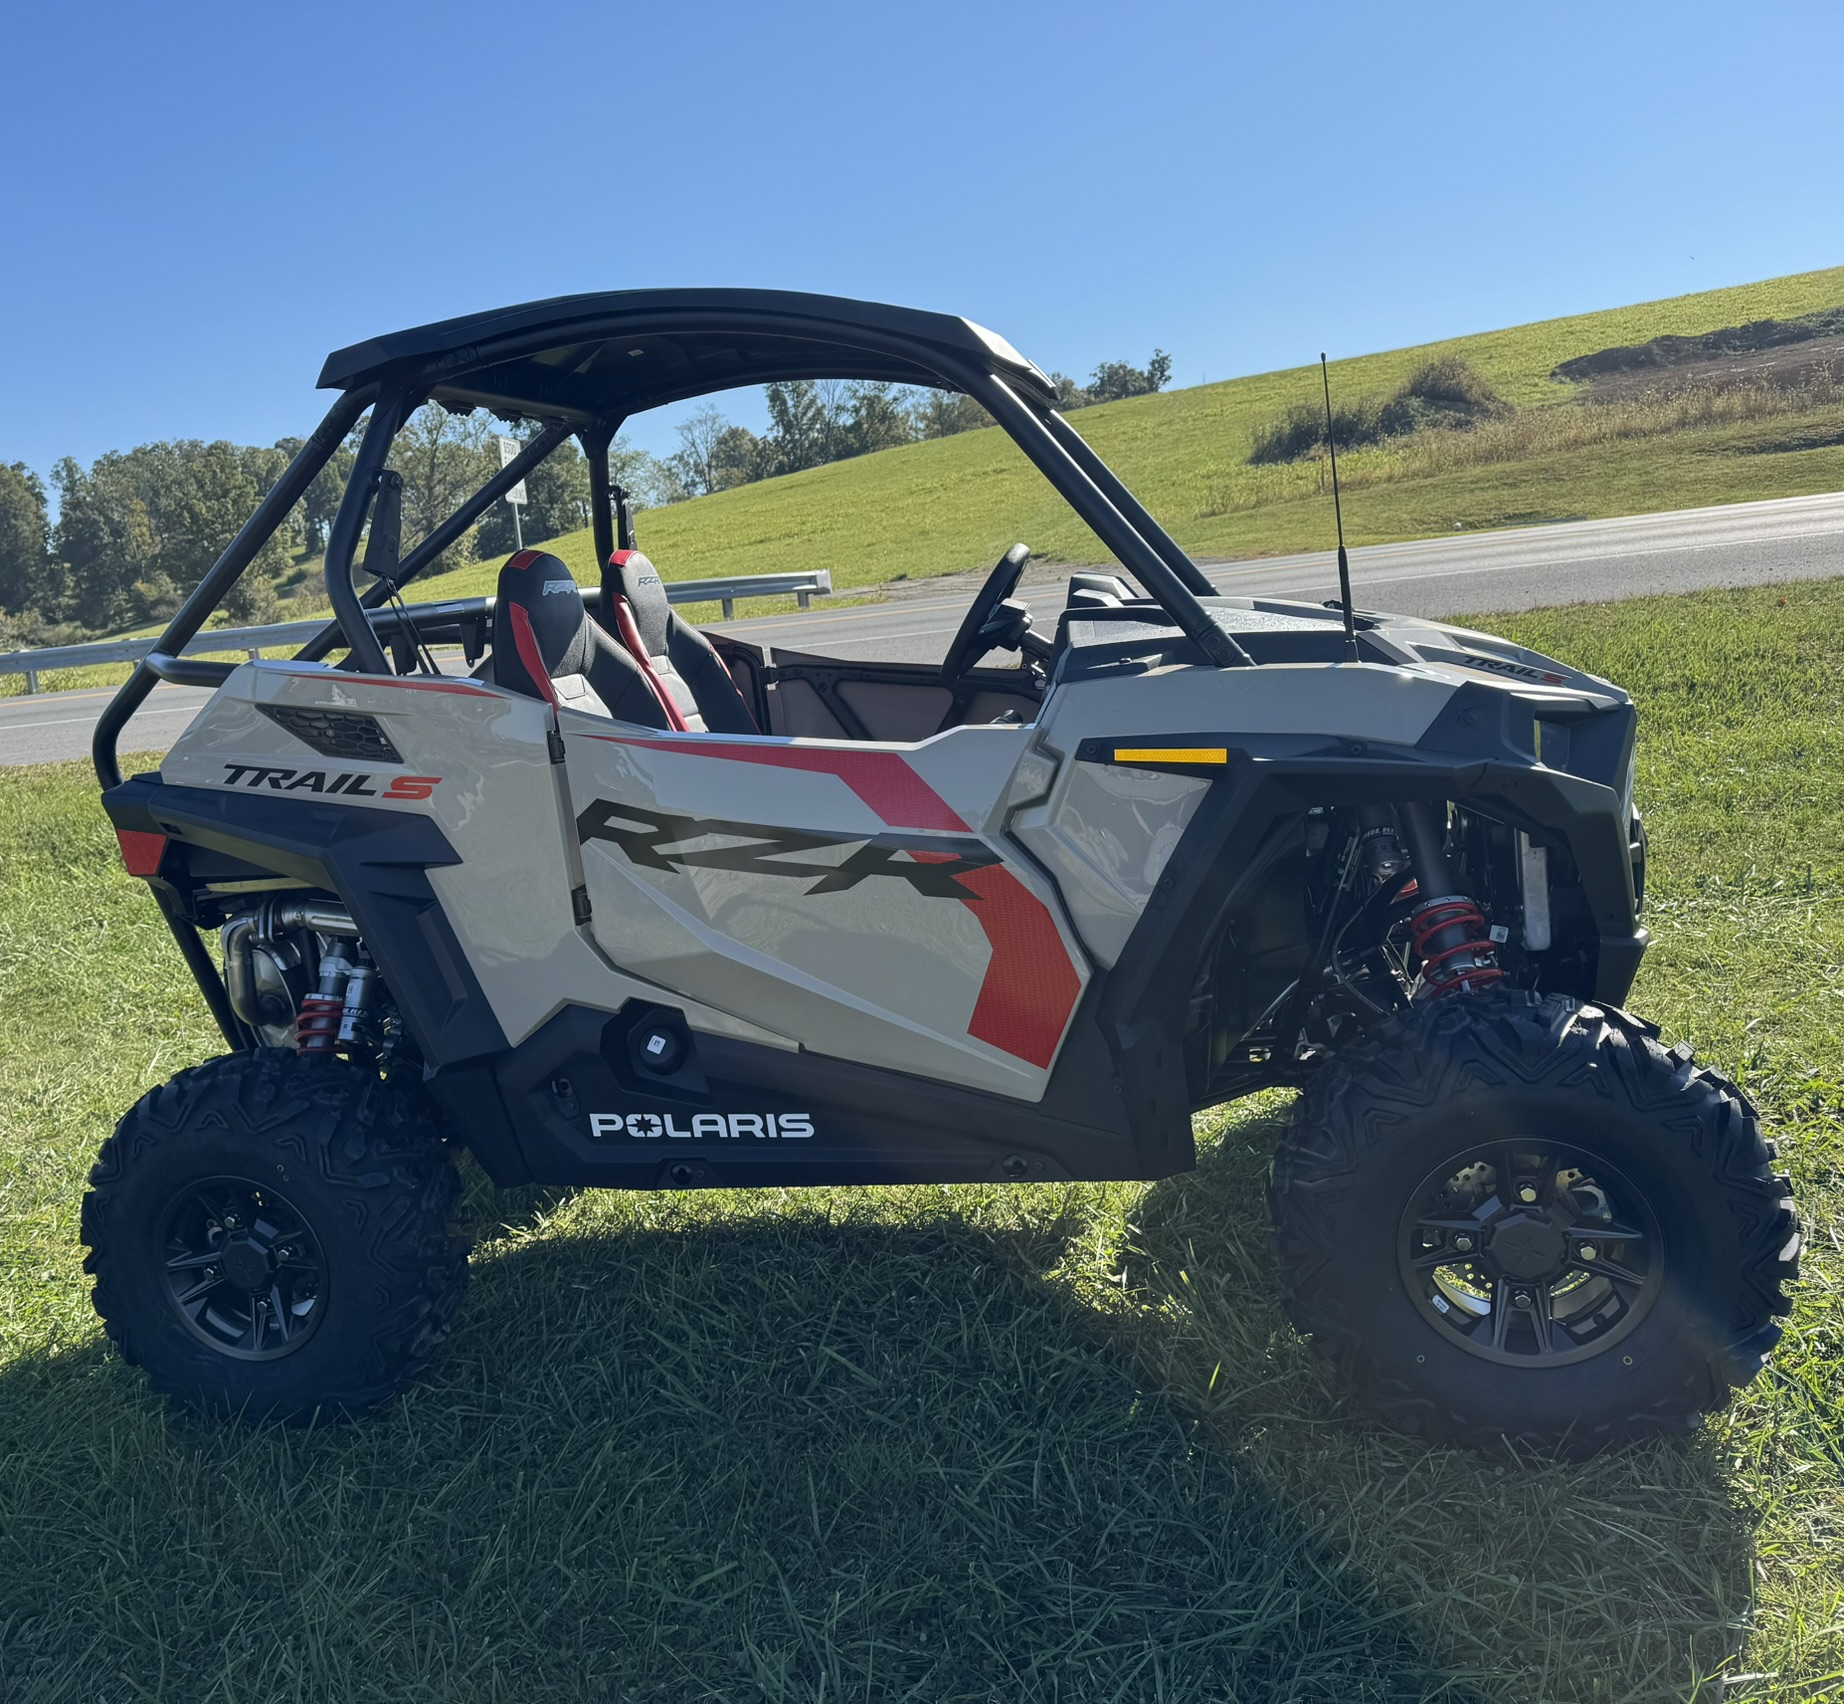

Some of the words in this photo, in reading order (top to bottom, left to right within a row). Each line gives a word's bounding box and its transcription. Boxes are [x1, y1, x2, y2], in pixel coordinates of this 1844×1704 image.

[542, 579, 578, 596] RZR
[638, 576, 660, 587] RZR
[1463, 655, 1538, 678] TRAIL
[1542, 673, 1568, 684] S
[223, 763, 377, 796] TRAIL
[381, 776, 443, 800] S
[576, 798, 1004, 900] RZR
[589, 1113, 815, 1138] POLARIS
